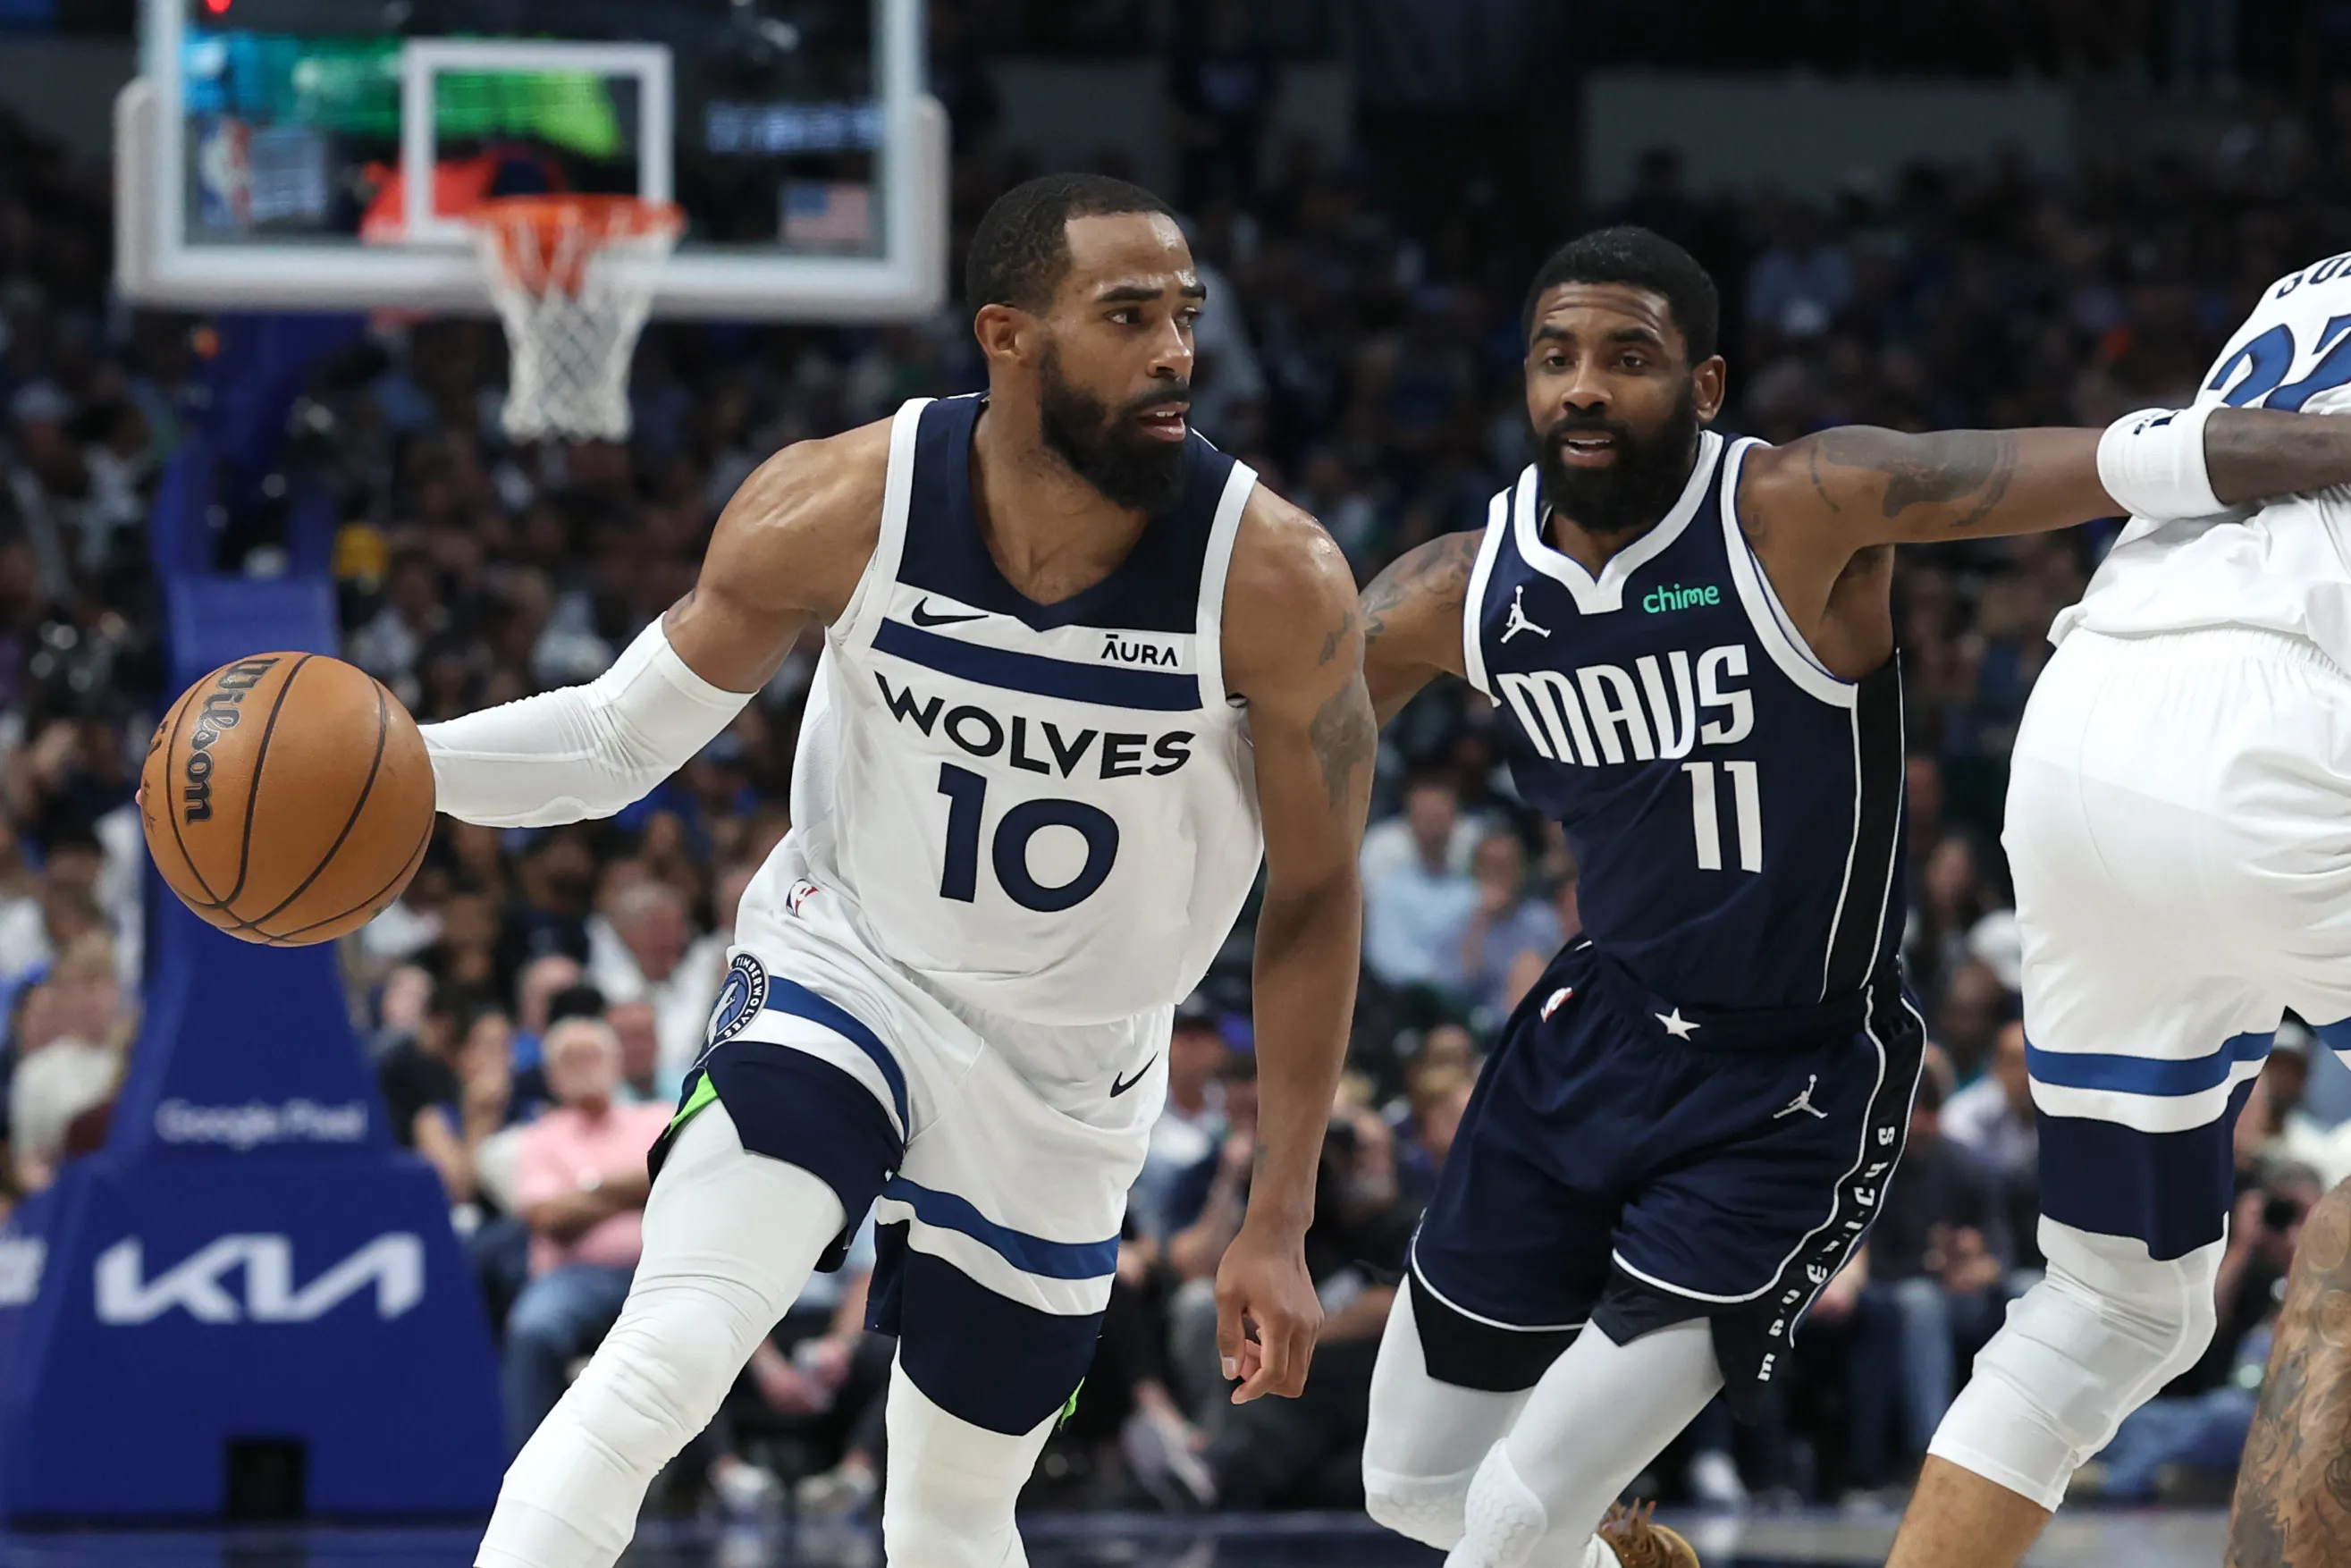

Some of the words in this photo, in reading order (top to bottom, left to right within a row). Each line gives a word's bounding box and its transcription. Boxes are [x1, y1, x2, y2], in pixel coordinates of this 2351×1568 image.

[1643, 583, 1721, 613] chime
[184, 658, 281, 824] Wilson
[873, 670, 1196, 780] WOLVES
[1496, 644, 1756, 767] MAVS
[937, 762, 1119, 913] 10
[1681, 761, 1763, 873] 11
[724, 957, 763, 1038] TIMBERWOLVES
